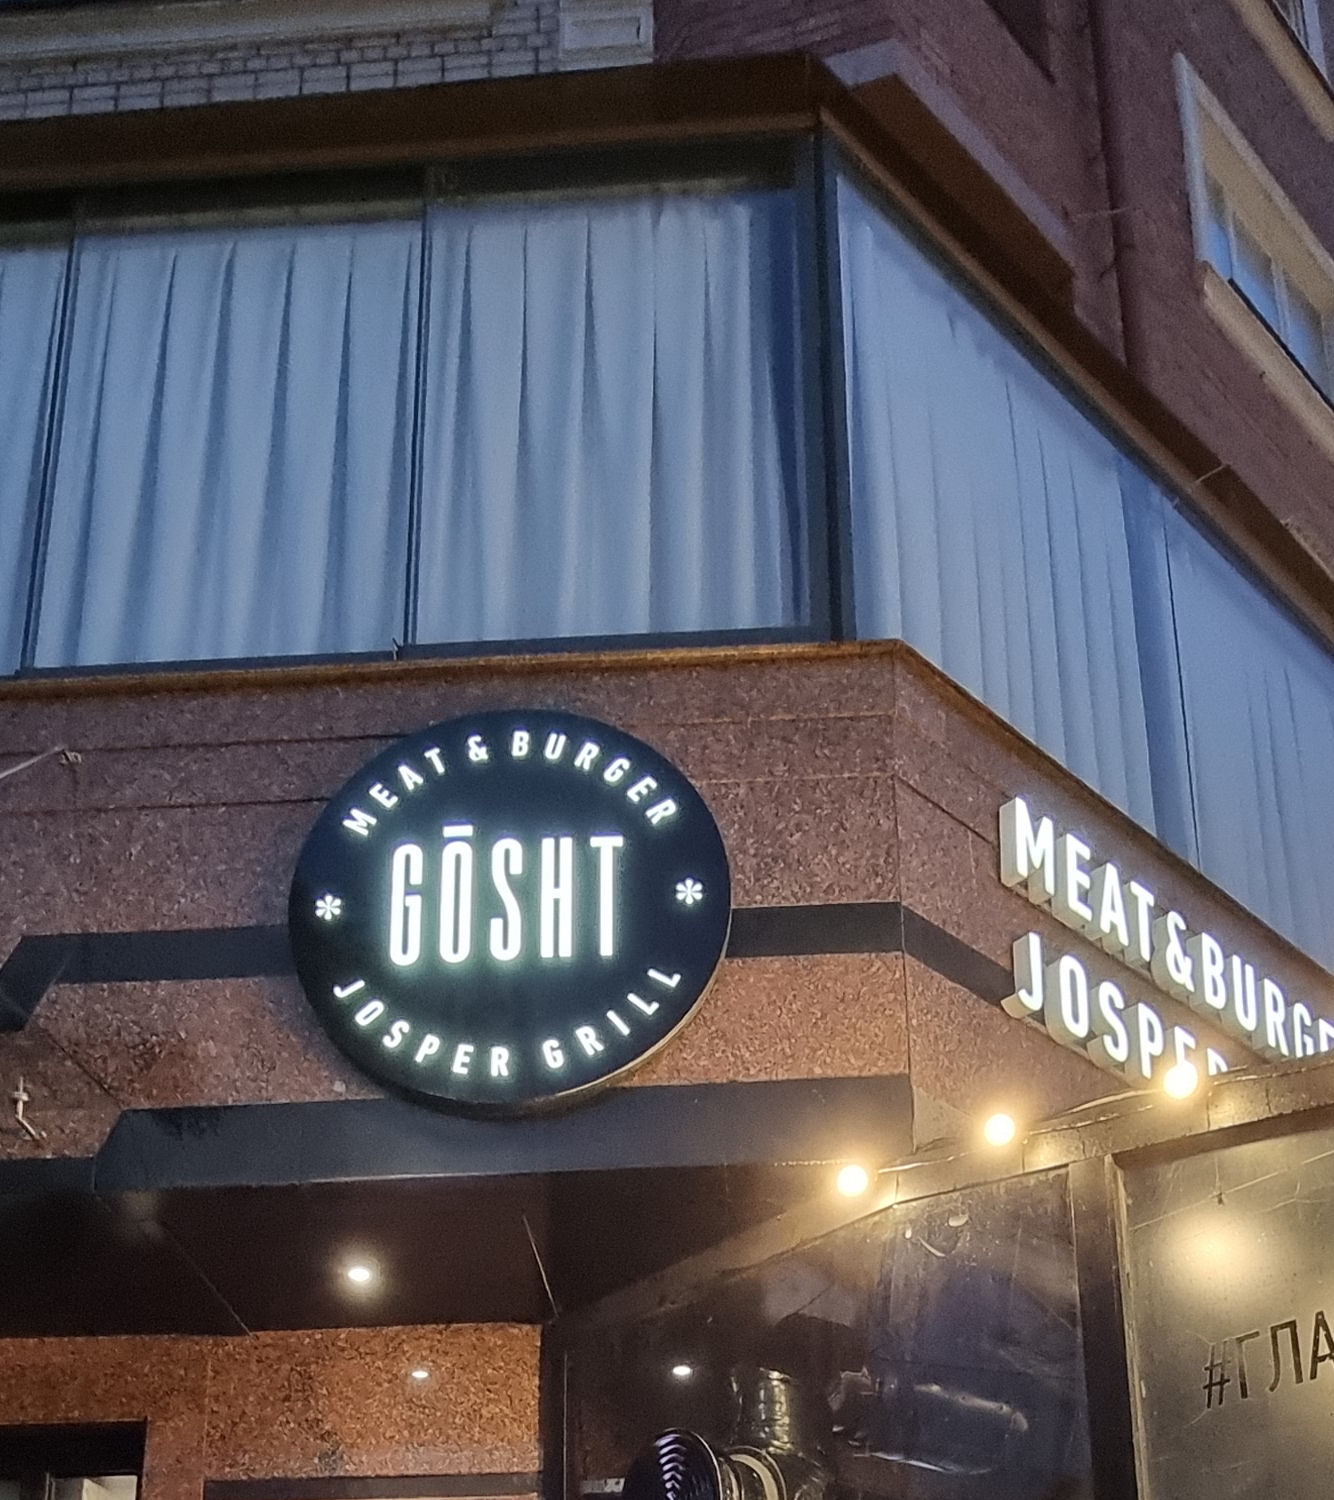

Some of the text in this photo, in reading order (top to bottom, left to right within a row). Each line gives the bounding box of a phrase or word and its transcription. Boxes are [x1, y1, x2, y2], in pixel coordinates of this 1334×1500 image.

[341, 729, 679, 837] MEAT & BURGER
[332, 966, 683, 1078] JOSPER GRILL
